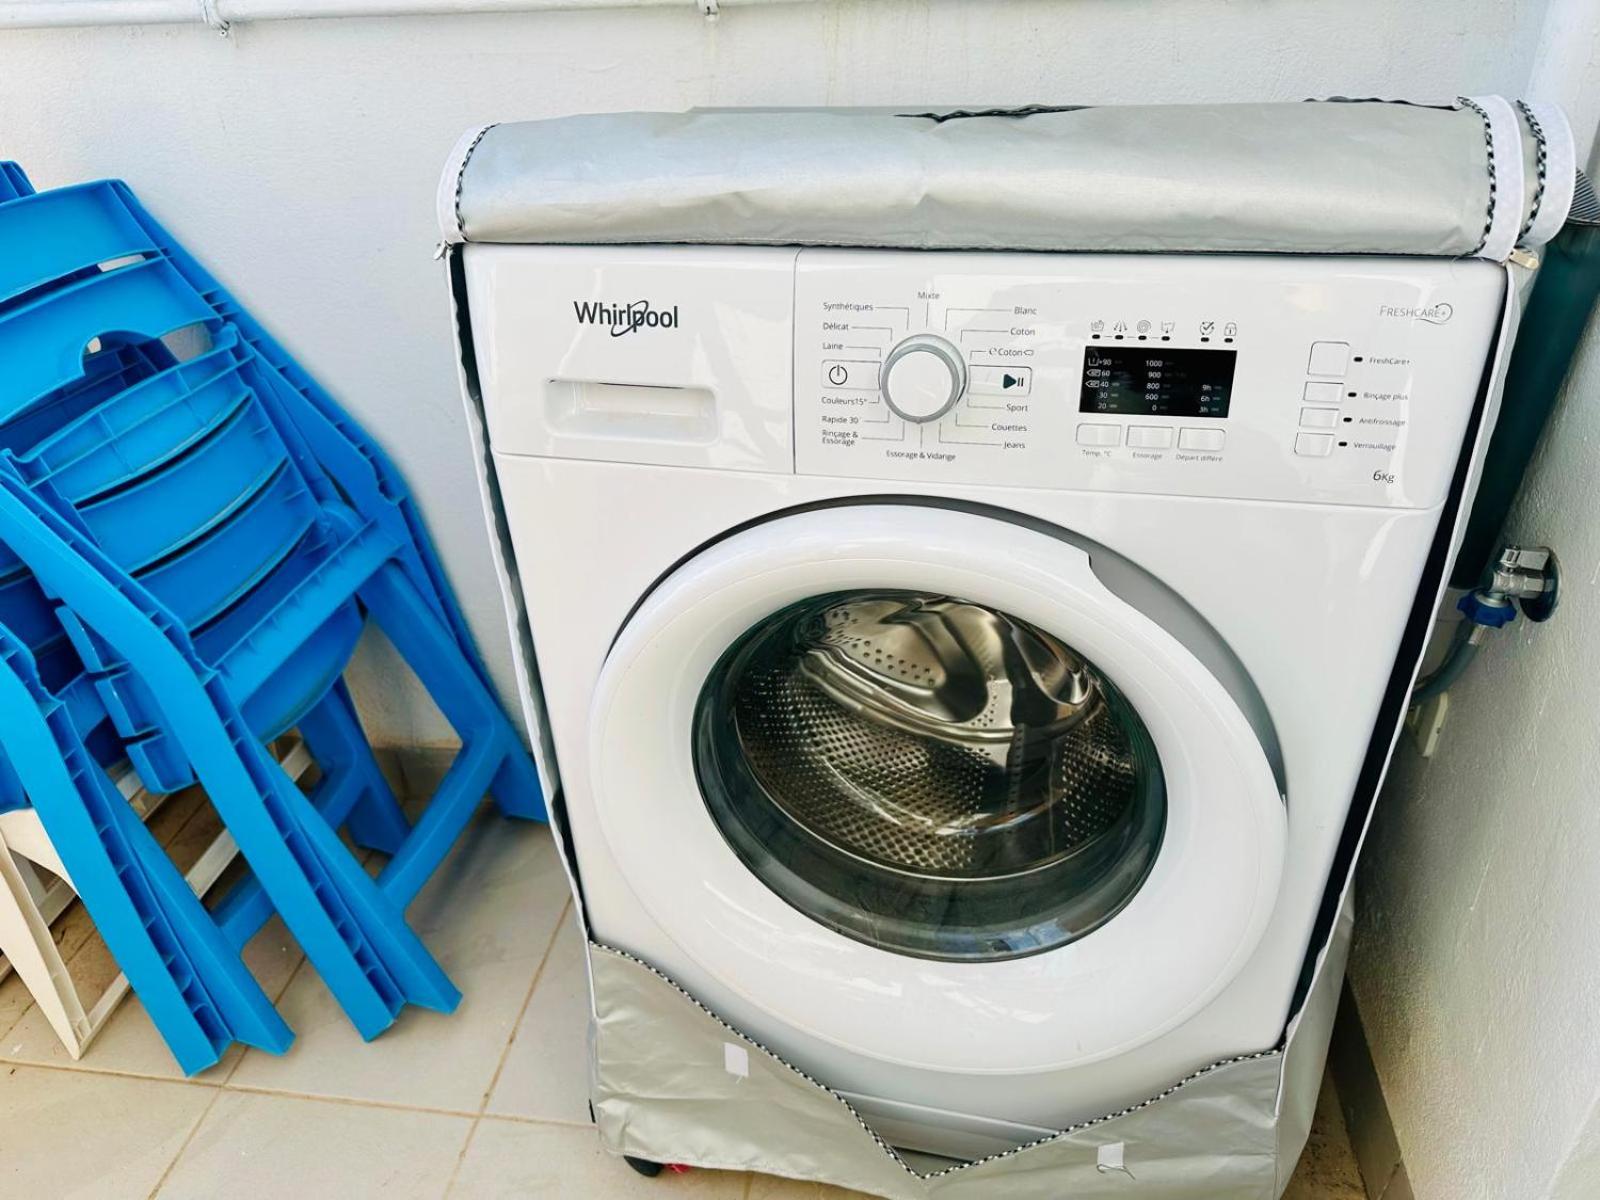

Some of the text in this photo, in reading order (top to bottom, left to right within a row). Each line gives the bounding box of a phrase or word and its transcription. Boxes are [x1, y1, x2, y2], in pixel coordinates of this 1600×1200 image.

[917, 291, 940, 300] Mixte
[823, 302, 874, 312] Synthétiques
[1014, 306, 1037, 315] Blanc
[573, 299, 679, 337] Whirlpool
[823, 322, 849, 331] Délicat
[1010, 327, 1036, 336] Coton
[822, 342, 844, 350] Laine
[998, 348, 1023, 357] Coton
[1148, 371, 1162, 379] 900
[1146, 382, 1160, 390] 800
[1145, 393, 1159, 401] 600
[1006, 402, 1028, 412] Sport
[821, 415, 847, 424] Rapide
[991, 423, 1028, 432] Couettes
[822, 430, 850, 439] Rinçage
[822, 437, 855, 446] Essorage
[1003, 441, 1026, 450] Jeans
[886, 450, 918, 460] Essorage
[926, 452, 956, 461] Vidange
